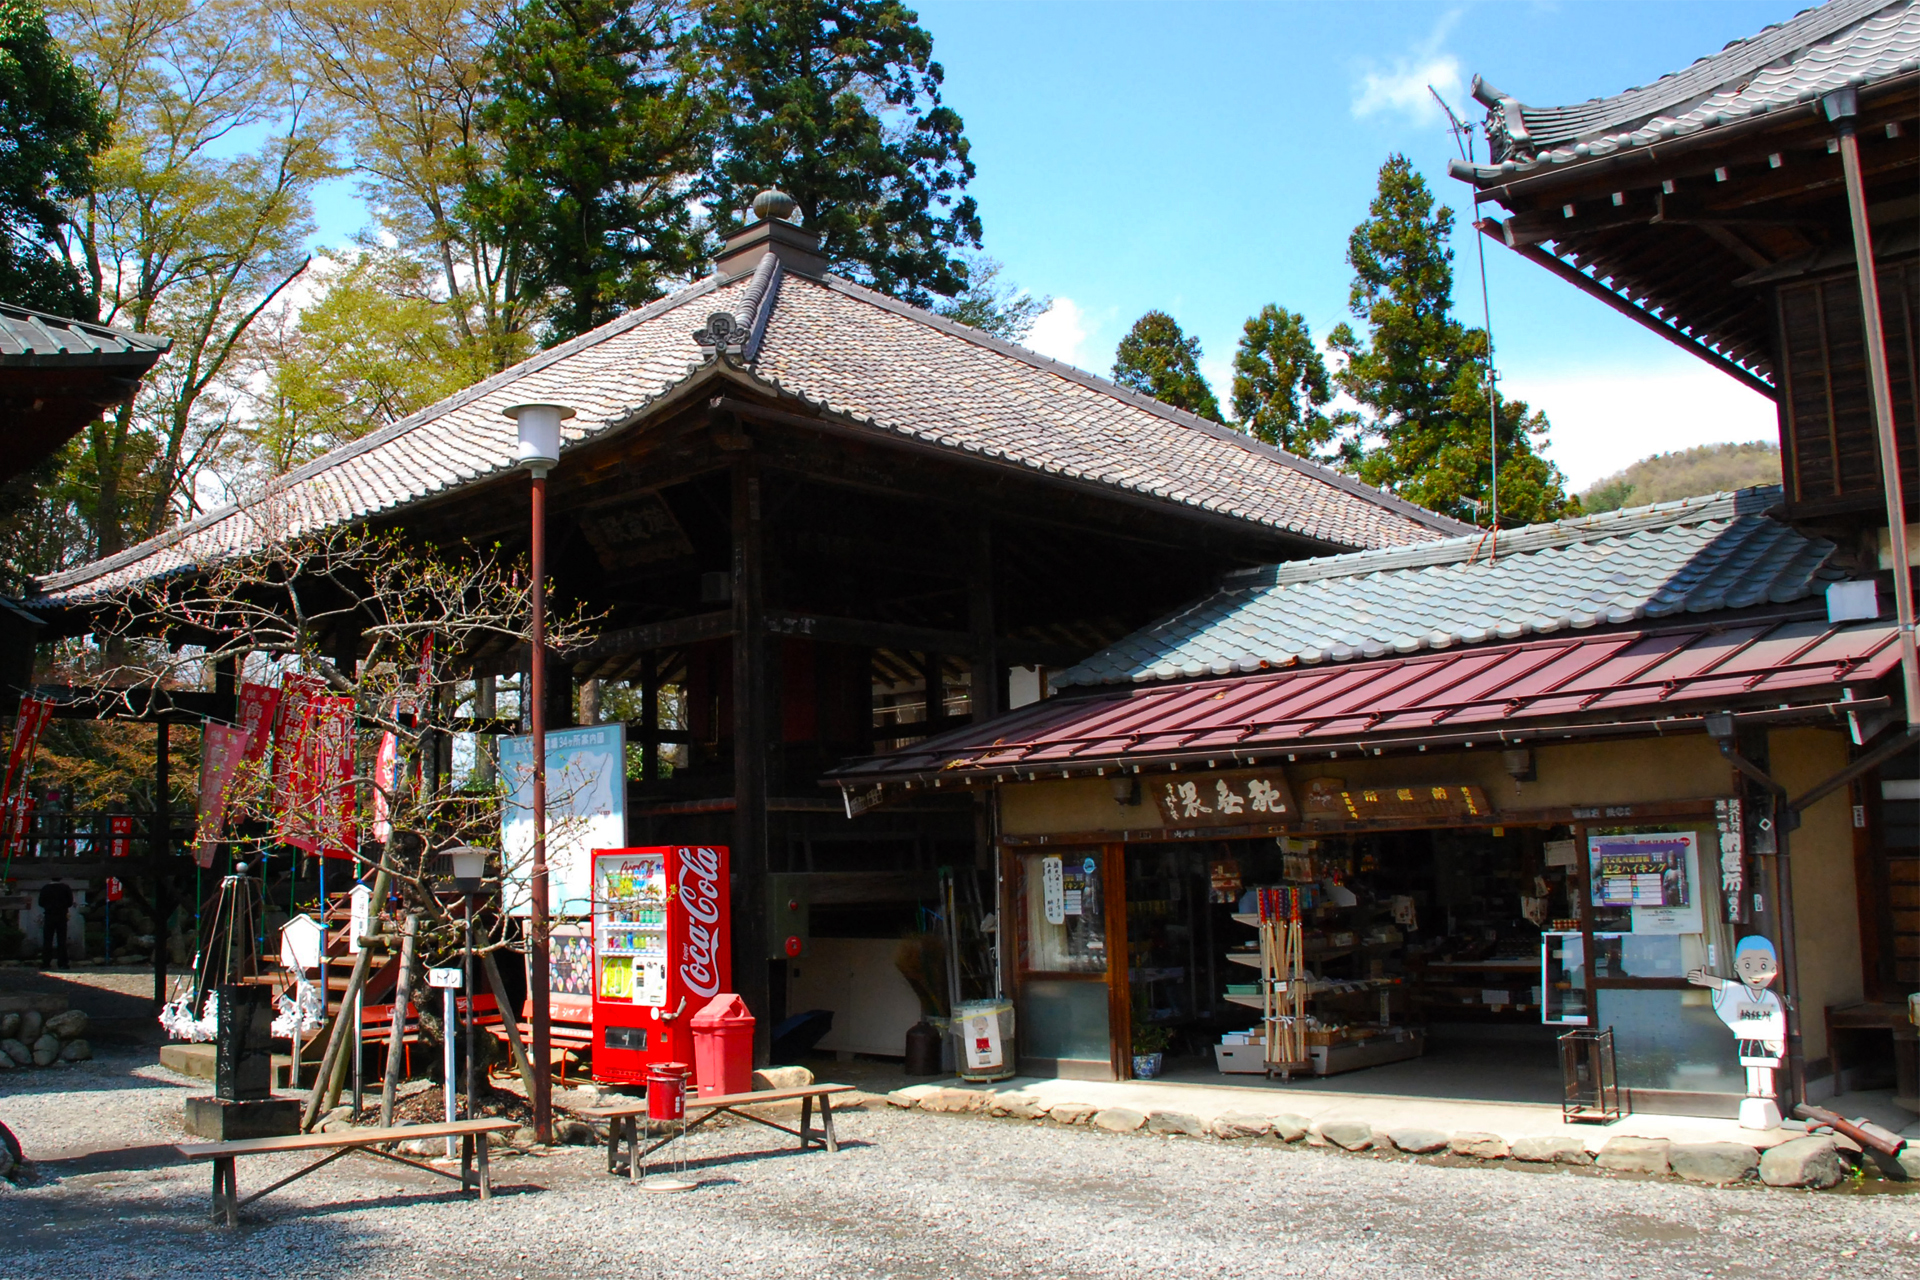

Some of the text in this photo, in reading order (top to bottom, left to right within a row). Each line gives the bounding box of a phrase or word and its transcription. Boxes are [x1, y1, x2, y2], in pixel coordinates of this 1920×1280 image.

[1602, 862, 1667, 874] 記念ハイキング
[678, 847, 720, 998] Coca-Cola
[436, 972, 458, 985] トイレ
